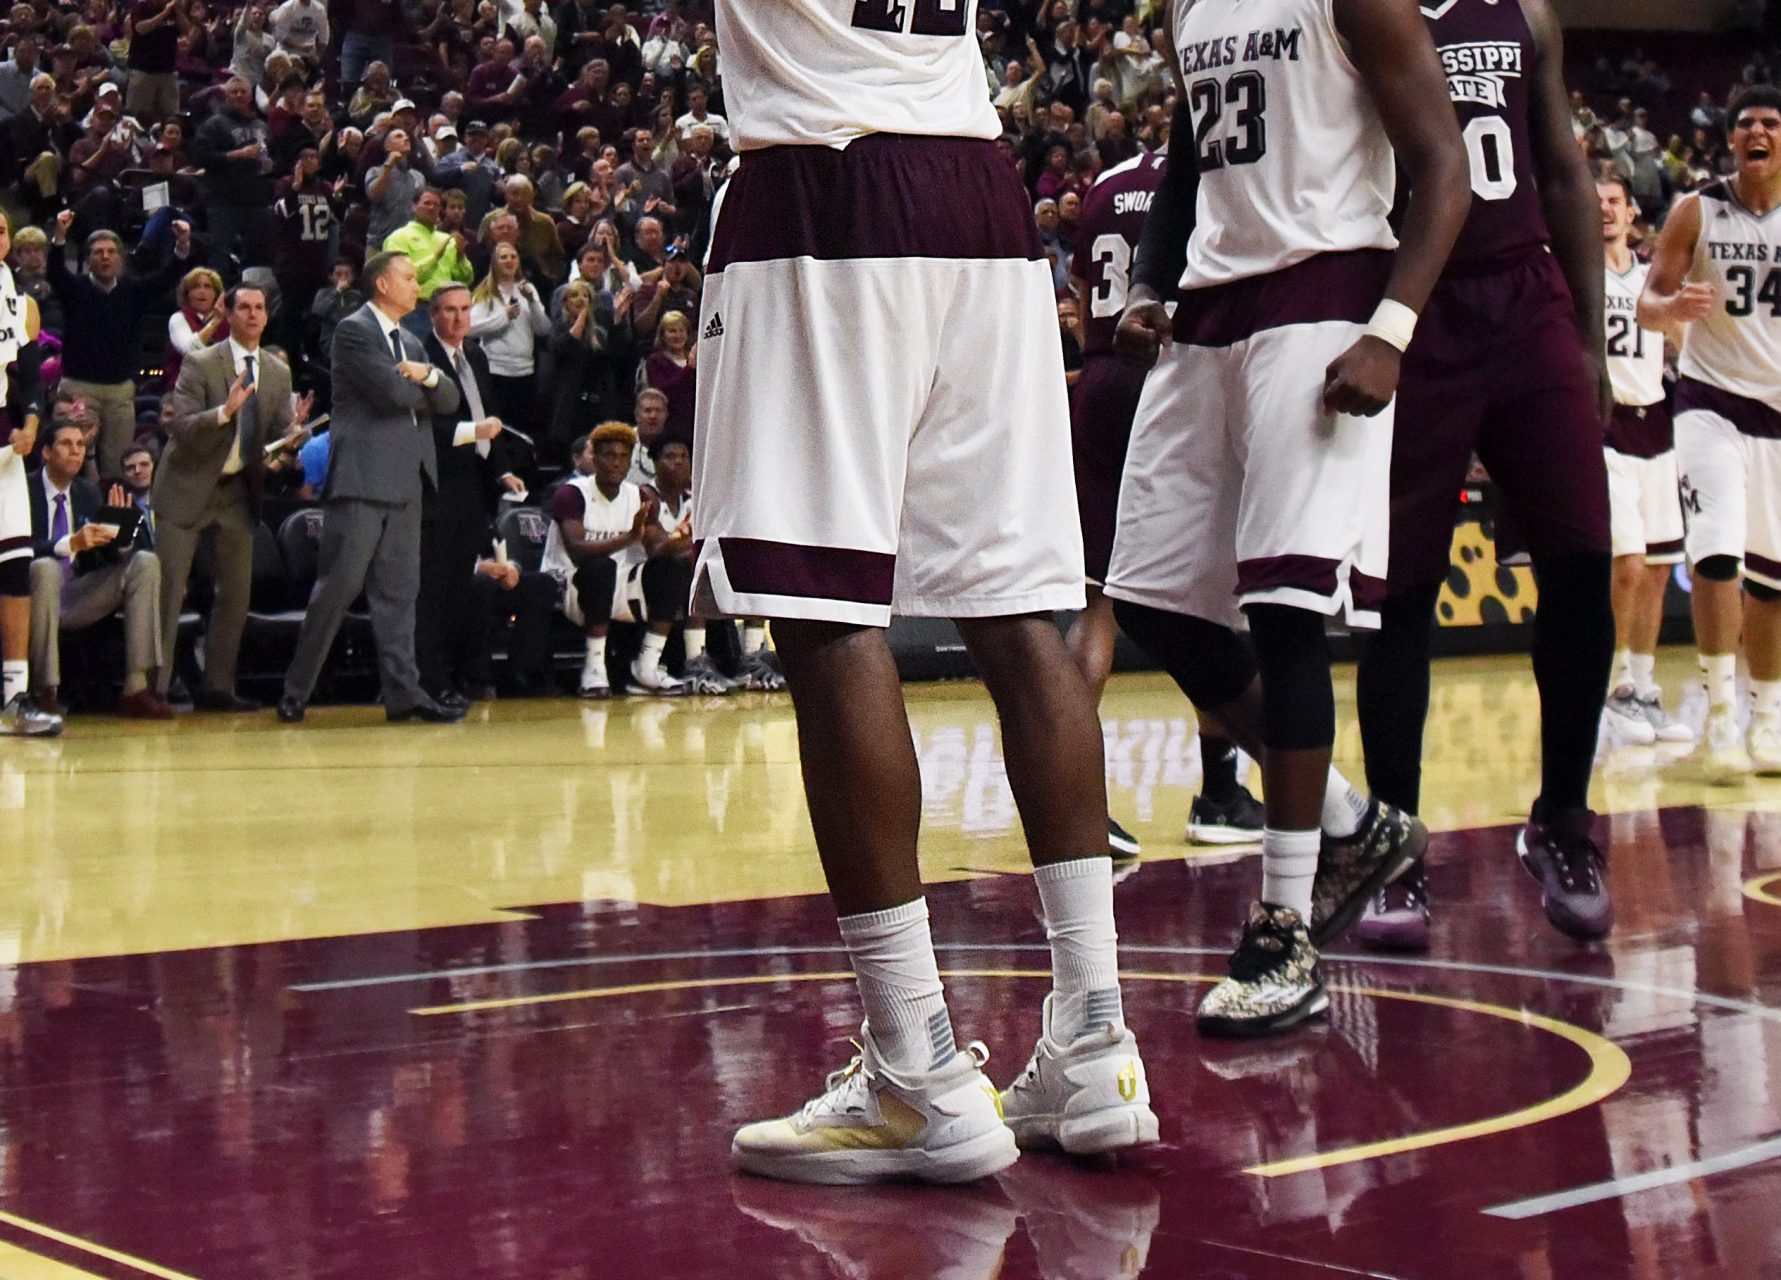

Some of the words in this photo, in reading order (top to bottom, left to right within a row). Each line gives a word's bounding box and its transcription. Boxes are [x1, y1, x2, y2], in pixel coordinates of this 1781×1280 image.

[1242, 28, 1303, 62] A&M
[1441, 46, 1522, 74] SSIPPI
[1448, 80, 1489, 101] ATE
[1190, 70, 1266, 173] 23
[1461, 115, 1517, 200] 0
[299, 204, 330, 240] 12
[1708, 241, 1767, 261] TEXAS
[1091, 233, 1145, 319] 3
[1725, 265, 1781, 318] 34
[1606, 295, 1634, 311] XAS
[1608, 314, 1644, 358] 21
